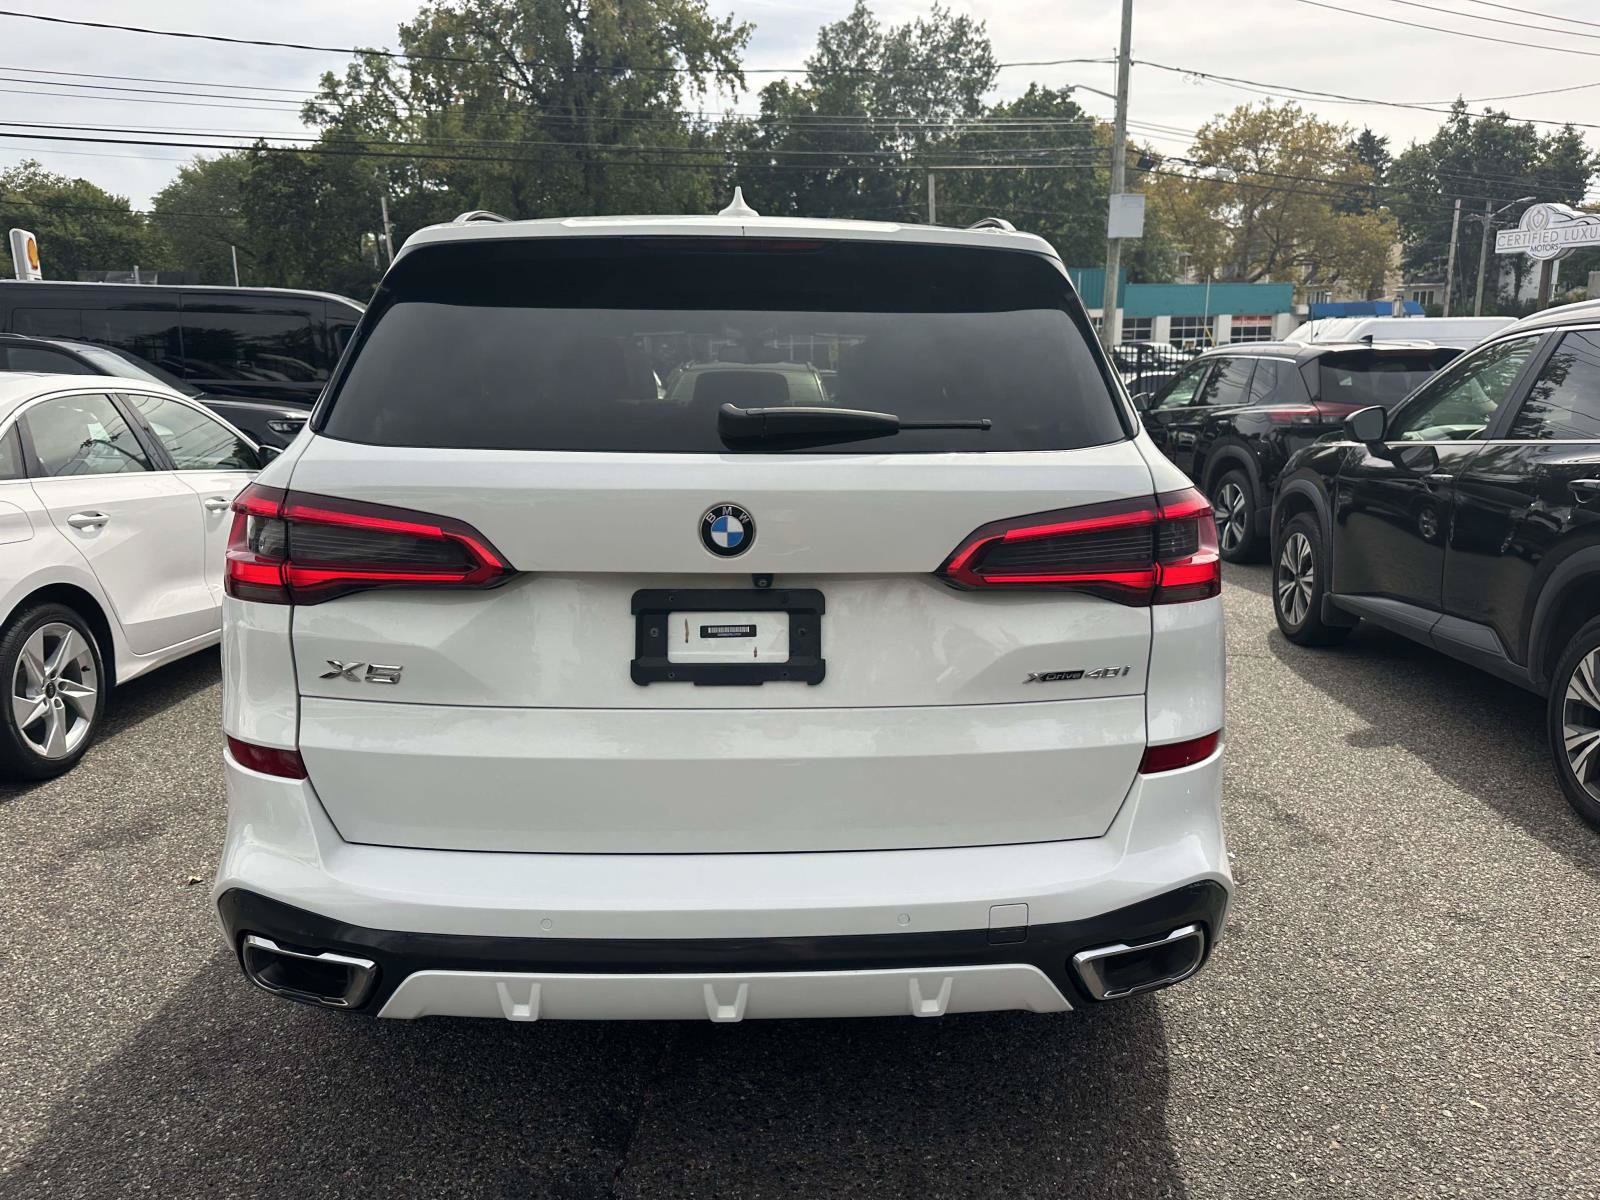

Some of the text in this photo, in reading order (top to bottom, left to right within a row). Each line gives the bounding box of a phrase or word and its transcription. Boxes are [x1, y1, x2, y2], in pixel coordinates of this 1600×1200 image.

[1497, 226, 1600, 247] CERTIFIED LUXU
[1530, 243, 1559, 252] MOTORS
[705, 506, 750, 524] BMW
[319, 660, 403, 684] X5
